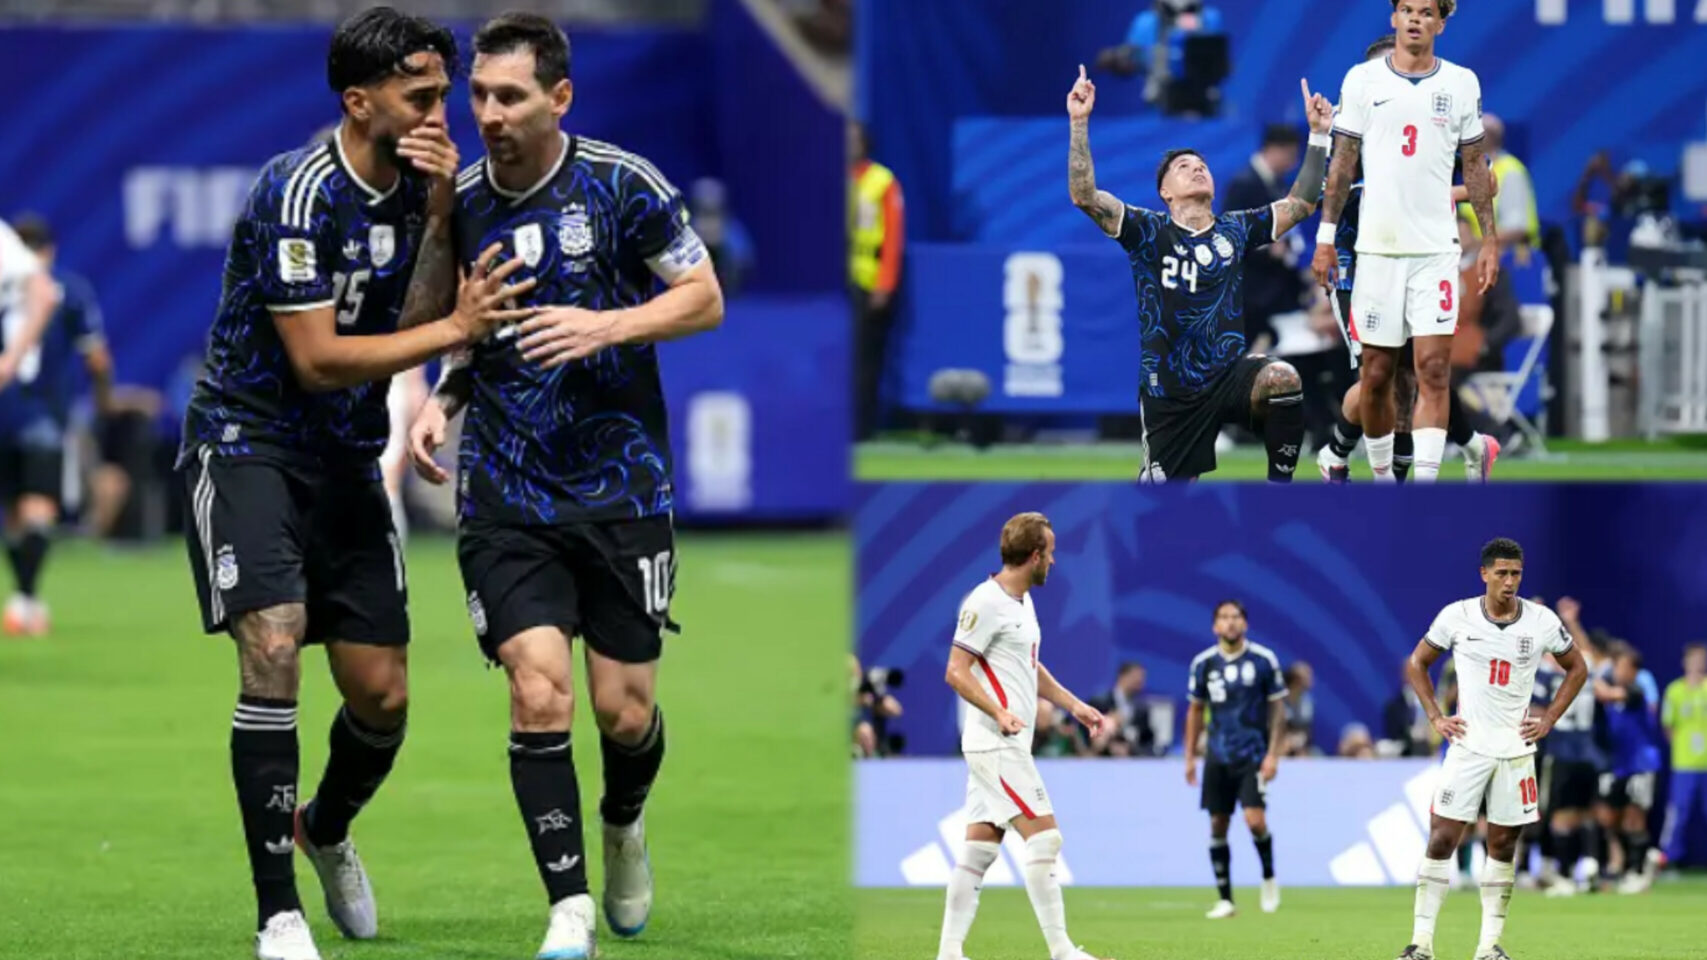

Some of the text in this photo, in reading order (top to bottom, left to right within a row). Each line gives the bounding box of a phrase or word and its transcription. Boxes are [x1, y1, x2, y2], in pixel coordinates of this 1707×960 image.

[1402, 124, 1418, 157] 3
[1162, 255, 1198, 293] 24
[1439, 280, 1453, 312] 3
[638, 550, 671, 614] 10
[1489, 658, 1511, 687] 10
[1519, 776, 1537, 805] 10
